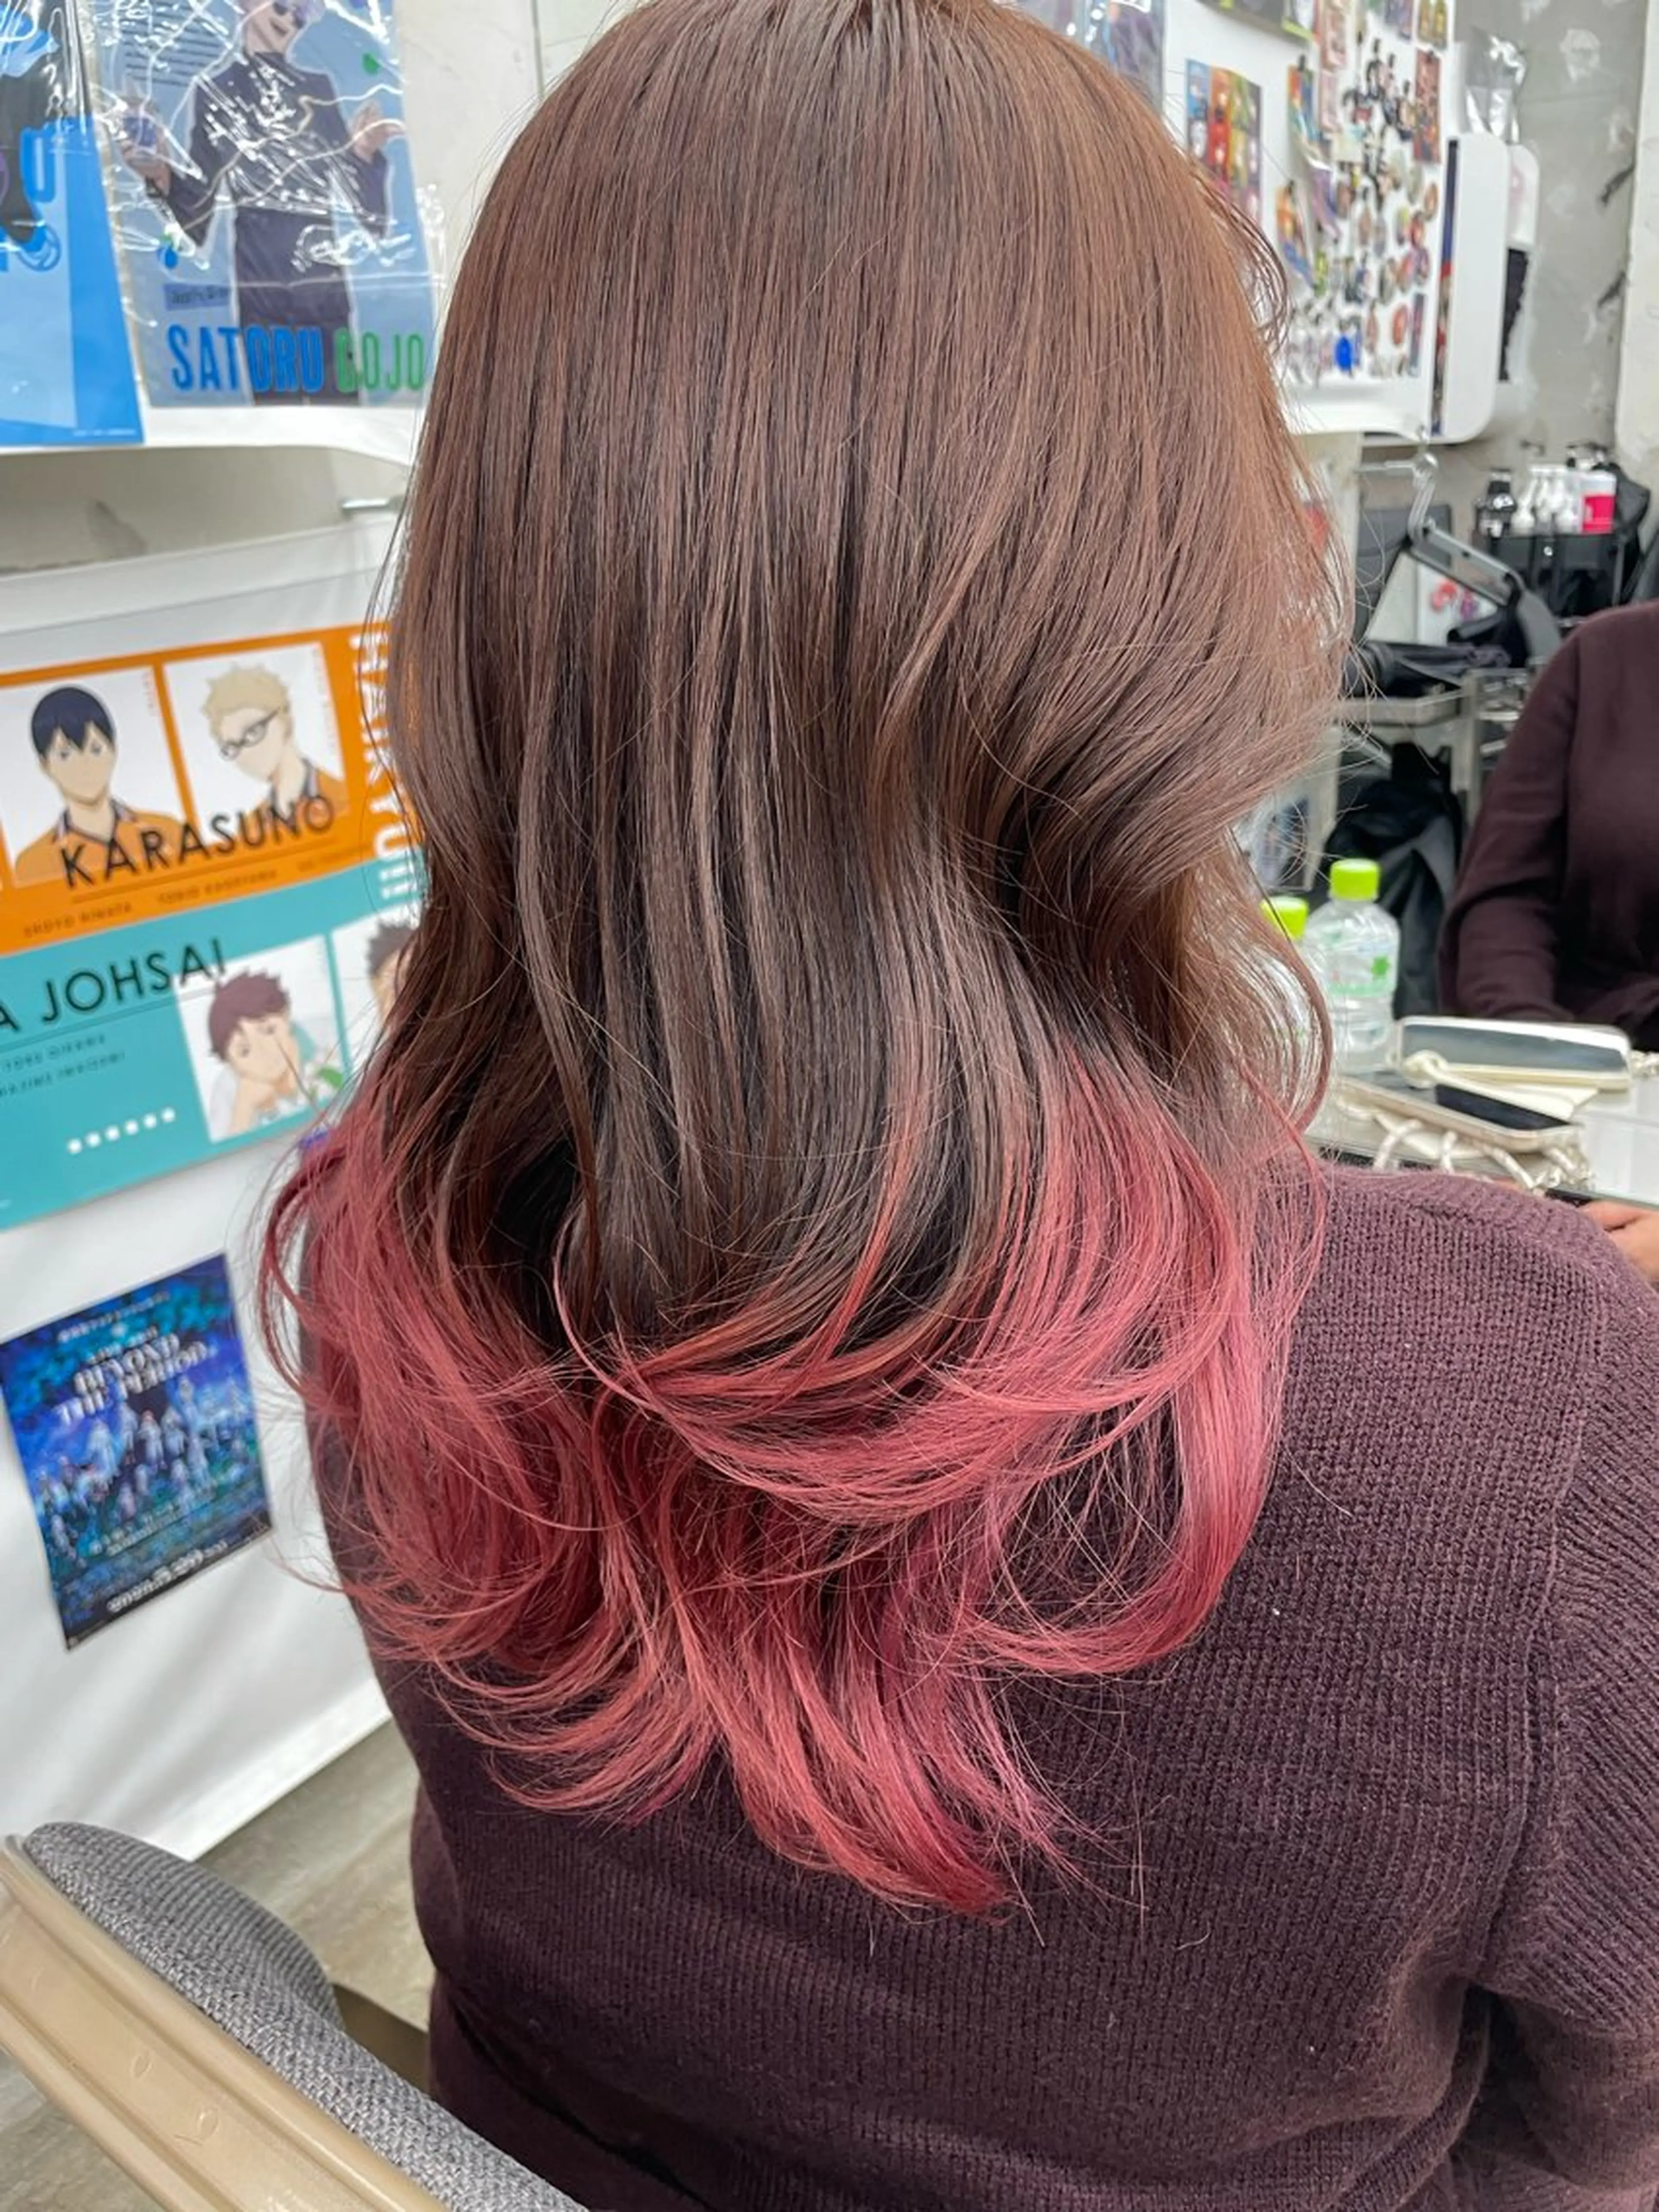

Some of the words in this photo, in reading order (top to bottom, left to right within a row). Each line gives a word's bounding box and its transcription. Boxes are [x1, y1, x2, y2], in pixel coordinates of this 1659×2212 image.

[167, 324, 324, 394] SATORU
[334, 327, 425, 393] GOJO
[60, 794, 334, 888] KARASUNO
[42, 938, 226, 1023] JOHSAI
